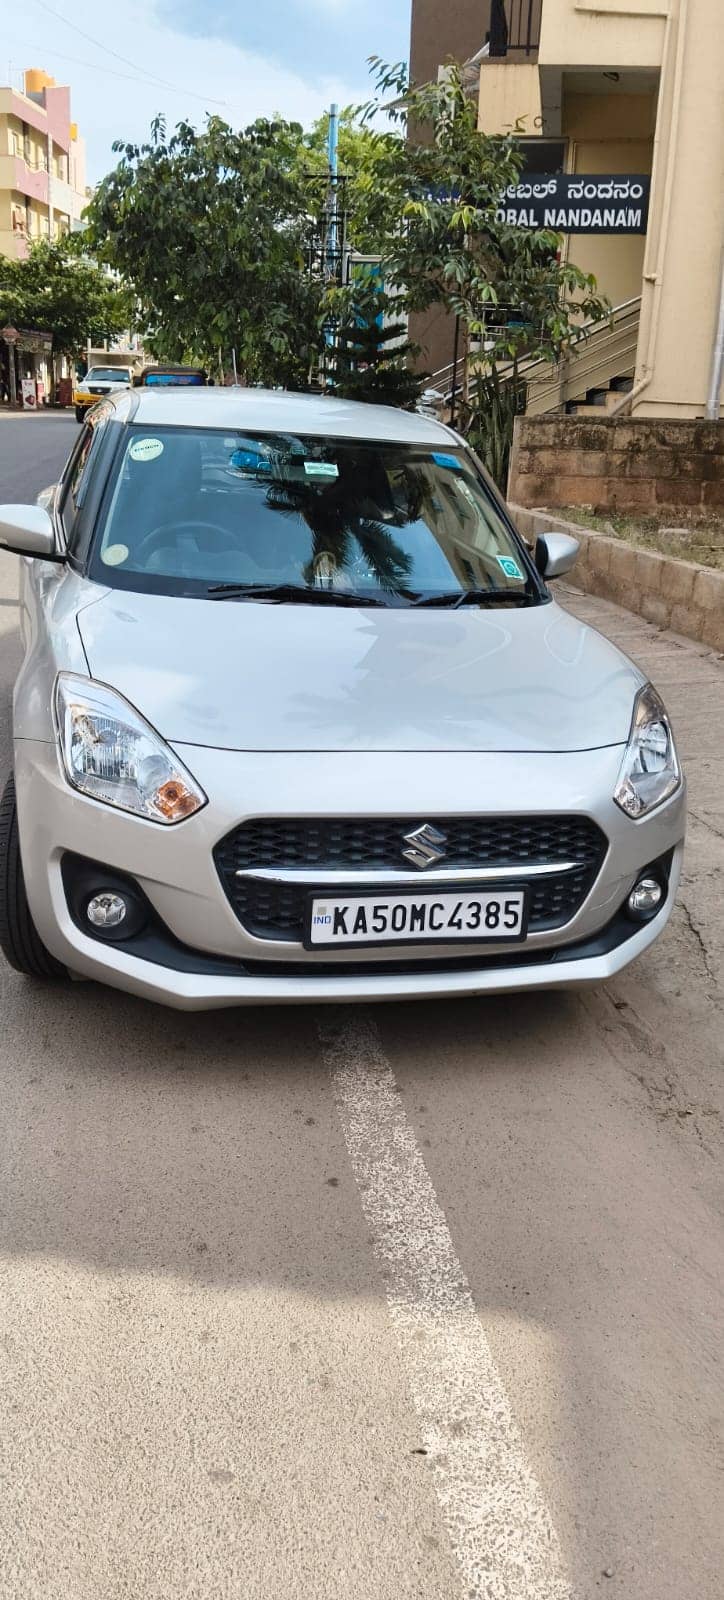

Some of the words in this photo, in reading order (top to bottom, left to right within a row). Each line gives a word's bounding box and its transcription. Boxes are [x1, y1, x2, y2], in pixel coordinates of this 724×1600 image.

[567, 180, 643, 199] ನಂದನಂ
[544, 208, 641, 227] NANDANAM
[313, 915, 331, 925] IND
[332, 900, 520, 935] KA50MC4385
